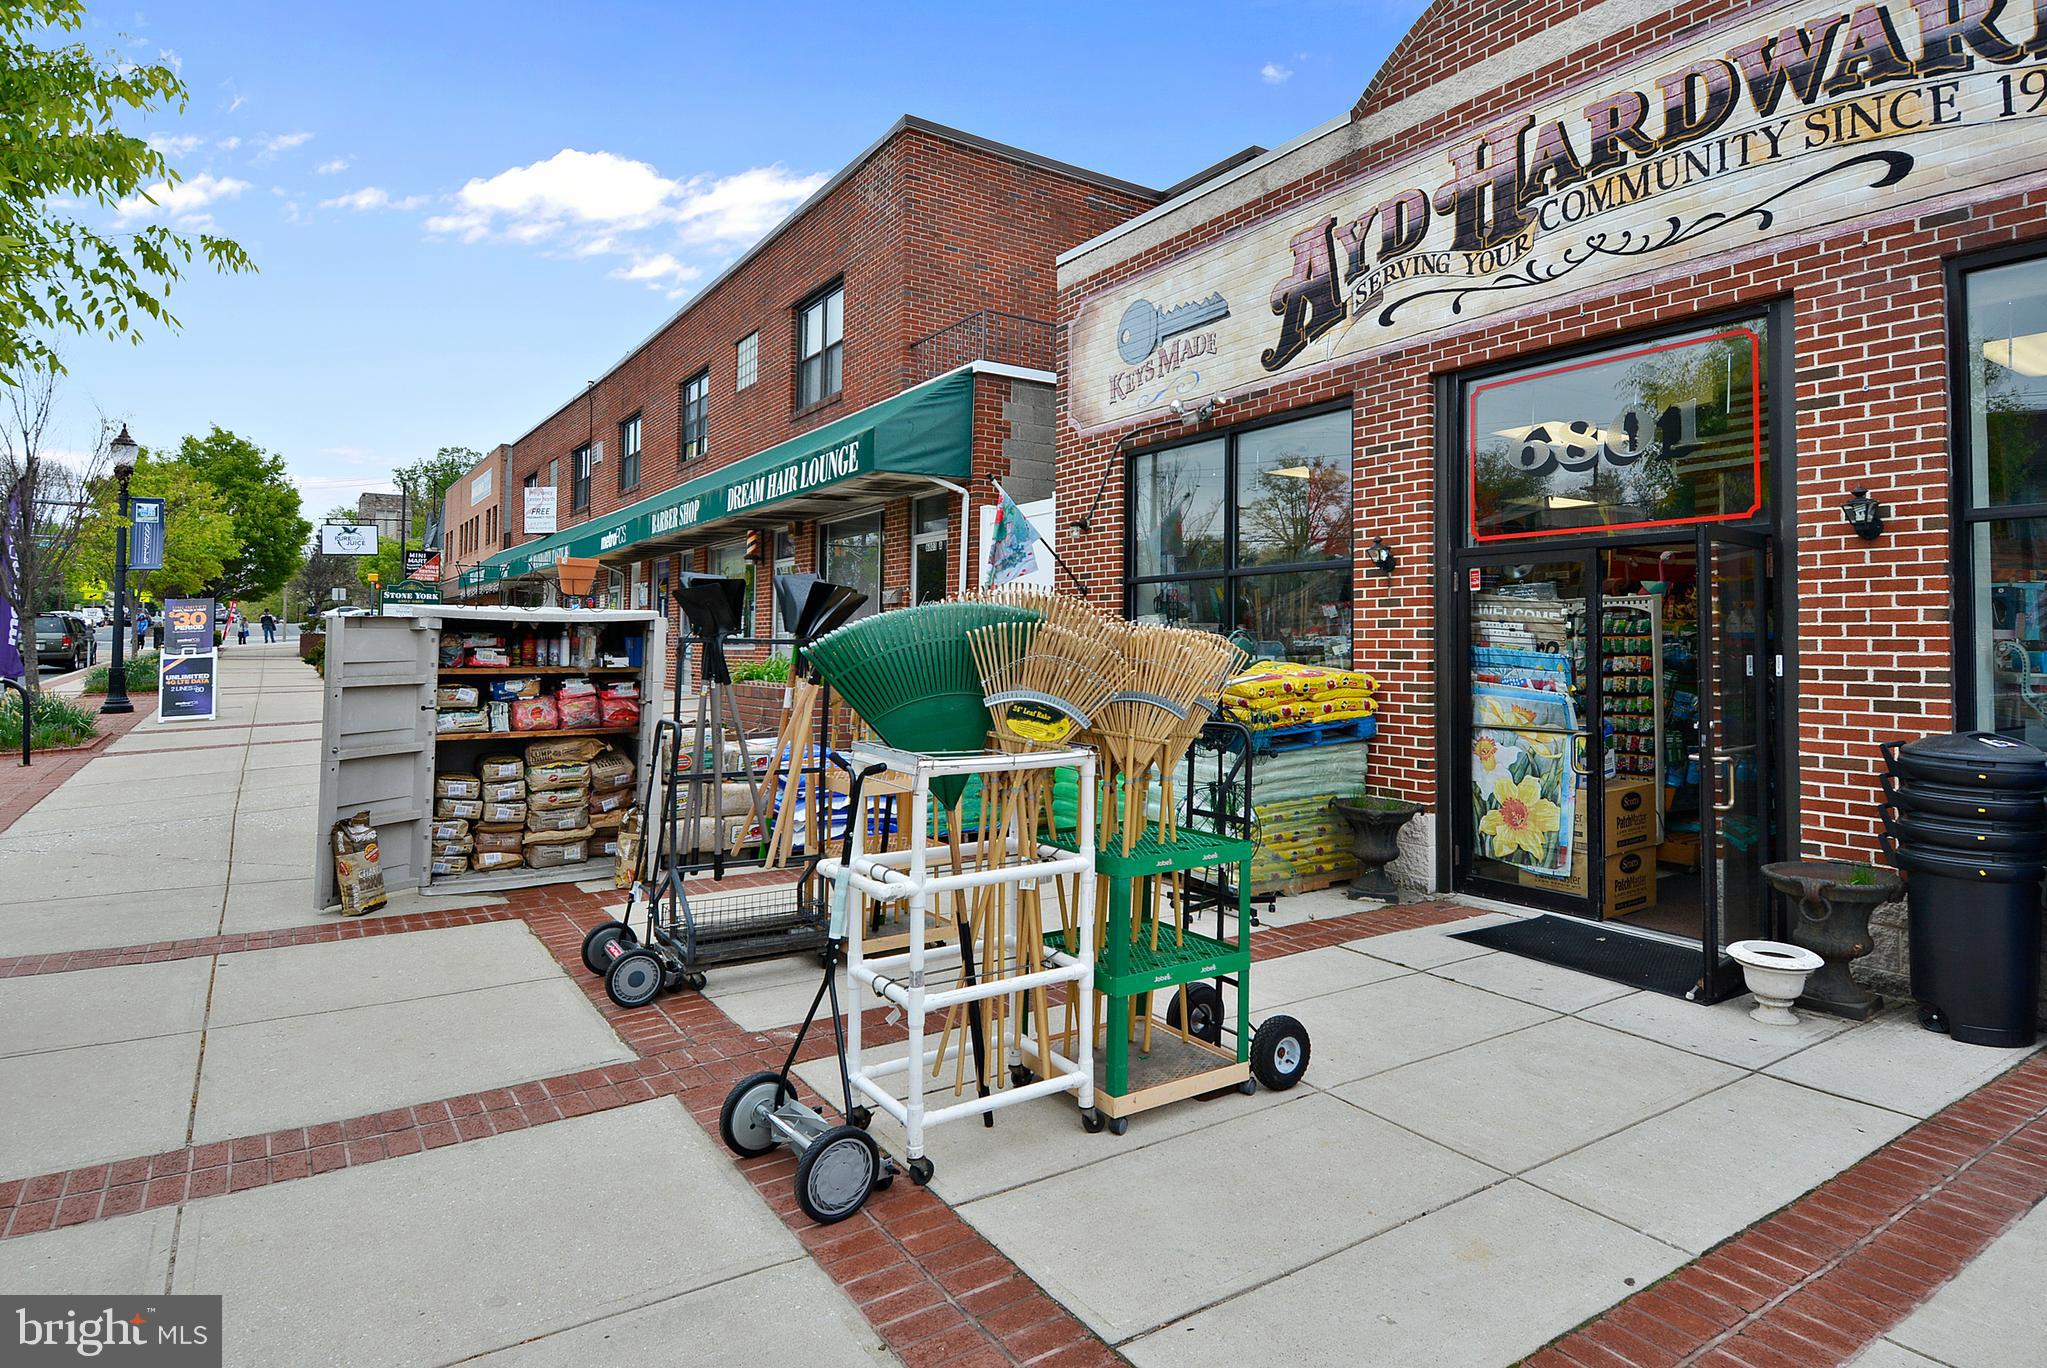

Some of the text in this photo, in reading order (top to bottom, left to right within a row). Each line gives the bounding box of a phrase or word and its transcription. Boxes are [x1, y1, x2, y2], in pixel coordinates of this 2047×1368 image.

[1260, 0, 2047, 372] AYD HARDWAR
[1354, 252, 1451, 308] SERVING
[1465, 232, 1531, 276] YOUR
[1538, 119, 1791, 232] COMMUNITY
[1804, 80, 1962, 150] SINCE
[1109, 332, 1218, 405] KEYS MADE
[1508, 398, 1707, 477] 6801
[727, 440, 859, 512] DREAM HAIR LOUNGE
[530, 507, 551, 515] FREE
[651, 499, 700, 535] BARBER SHOP
[600, 524, 627, 550] metroPCS
[383, 591, 439, 600] STONE YORK
[165, 673, 210, 681] UNLIMITED
[1023, 707, 1037, 716] Leaf
[1037, 712, 1051, 720] Rake
